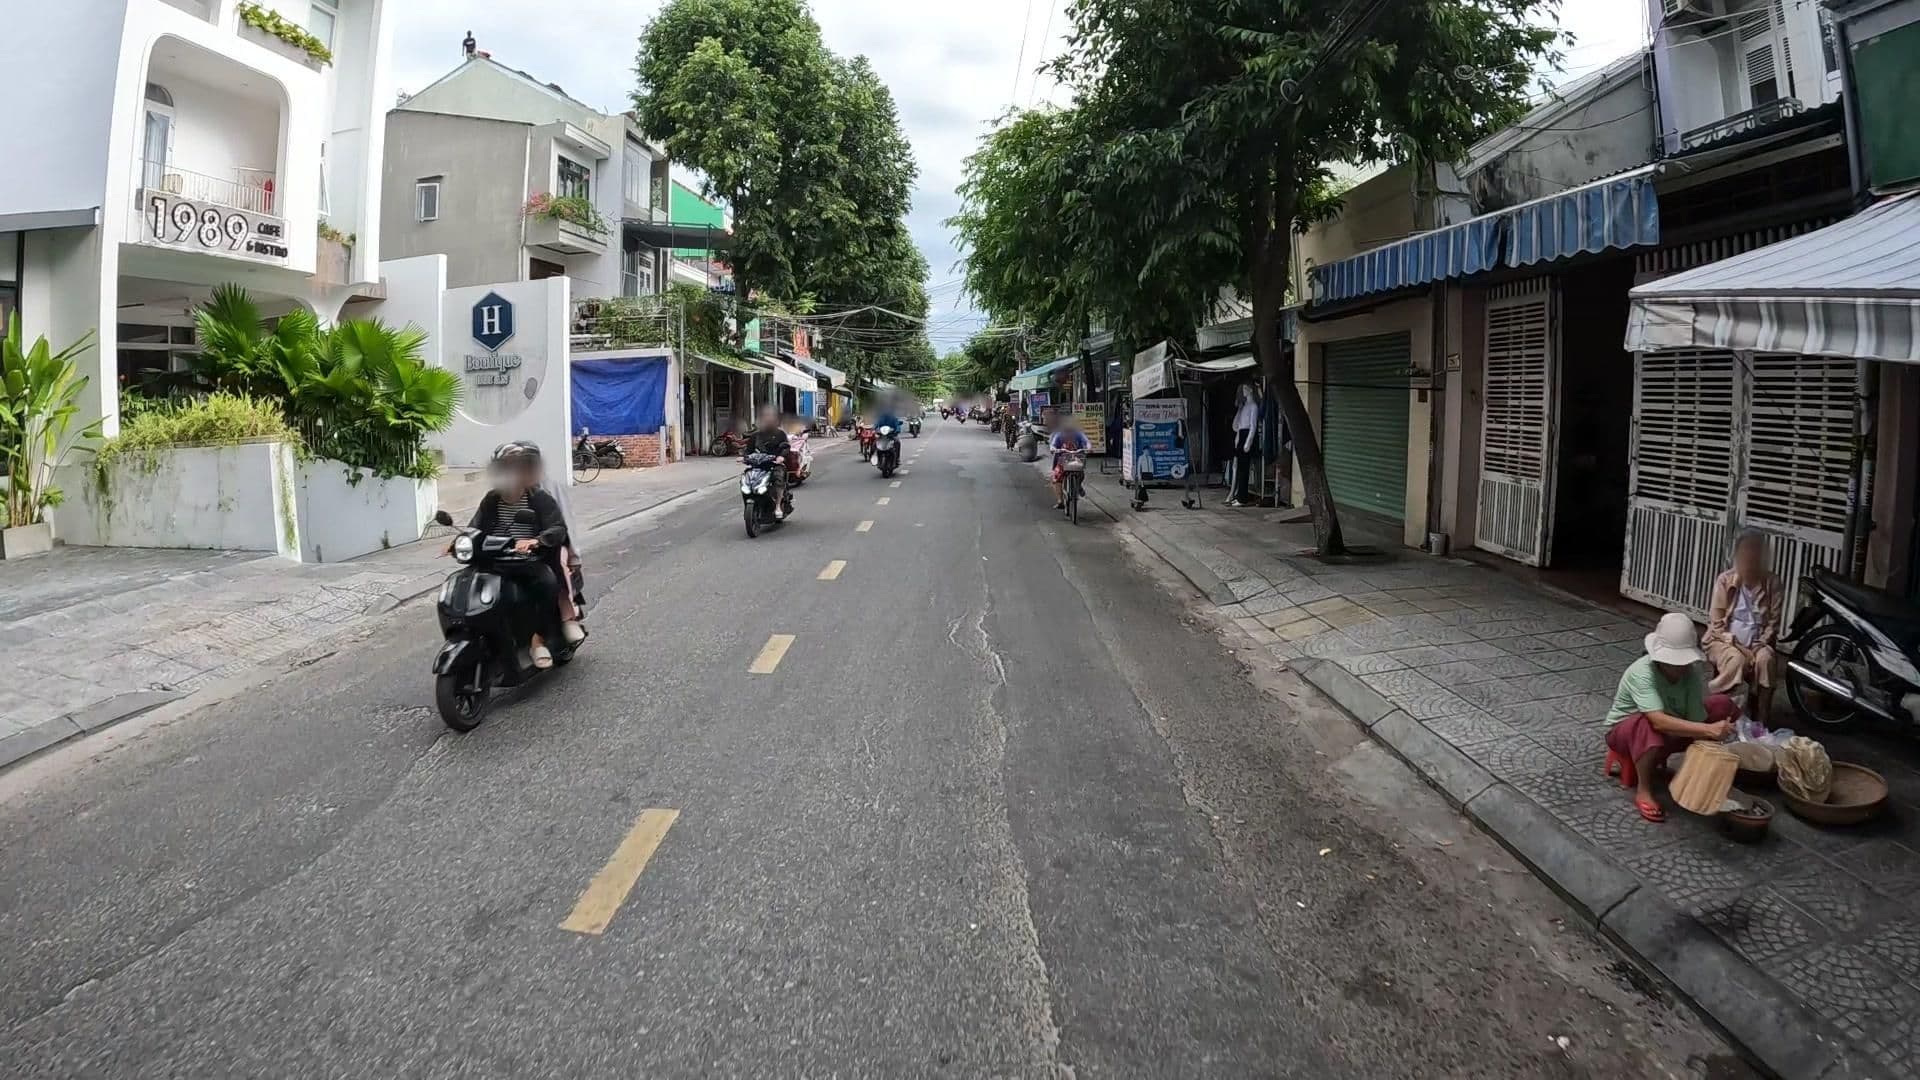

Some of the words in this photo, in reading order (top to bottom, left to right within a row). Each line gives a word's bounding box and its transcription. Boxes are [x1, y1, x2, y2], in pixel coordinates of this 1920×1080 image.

[151, 196, 249, 251] 1989
[480, 304, 503, 335] H
[464, 351, 523, 375] Boutique
